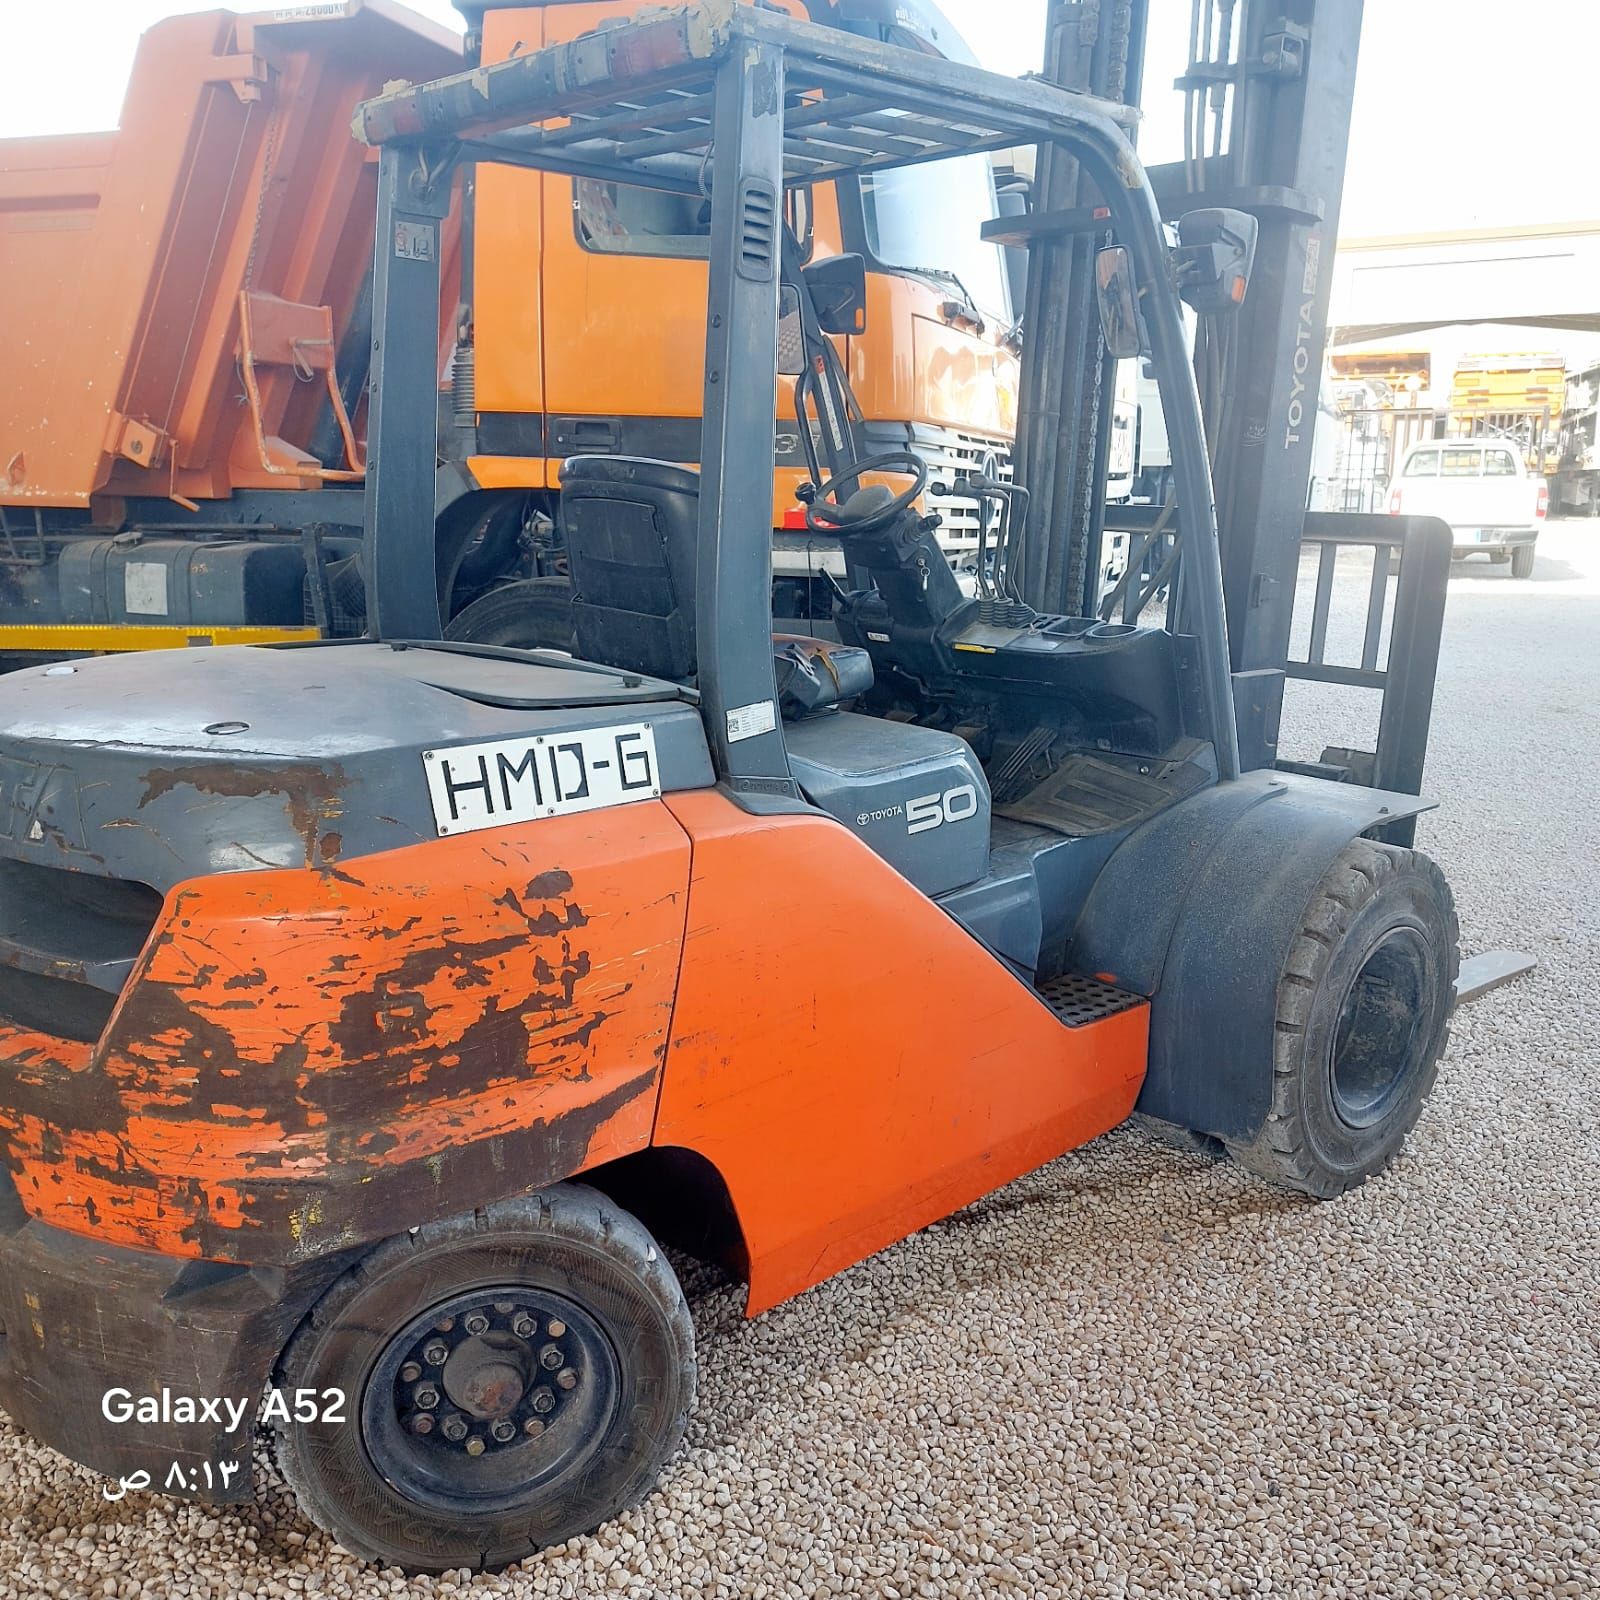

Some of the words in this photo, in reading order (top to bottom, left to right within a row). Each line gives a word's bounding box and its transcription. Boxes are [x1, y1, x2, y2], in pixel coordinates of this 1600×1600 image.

[1285, 299, 1313, 449] TOYOTA
[870, 805, 903, 821] TOYOTA
[906, 784, 978, 835] 50
